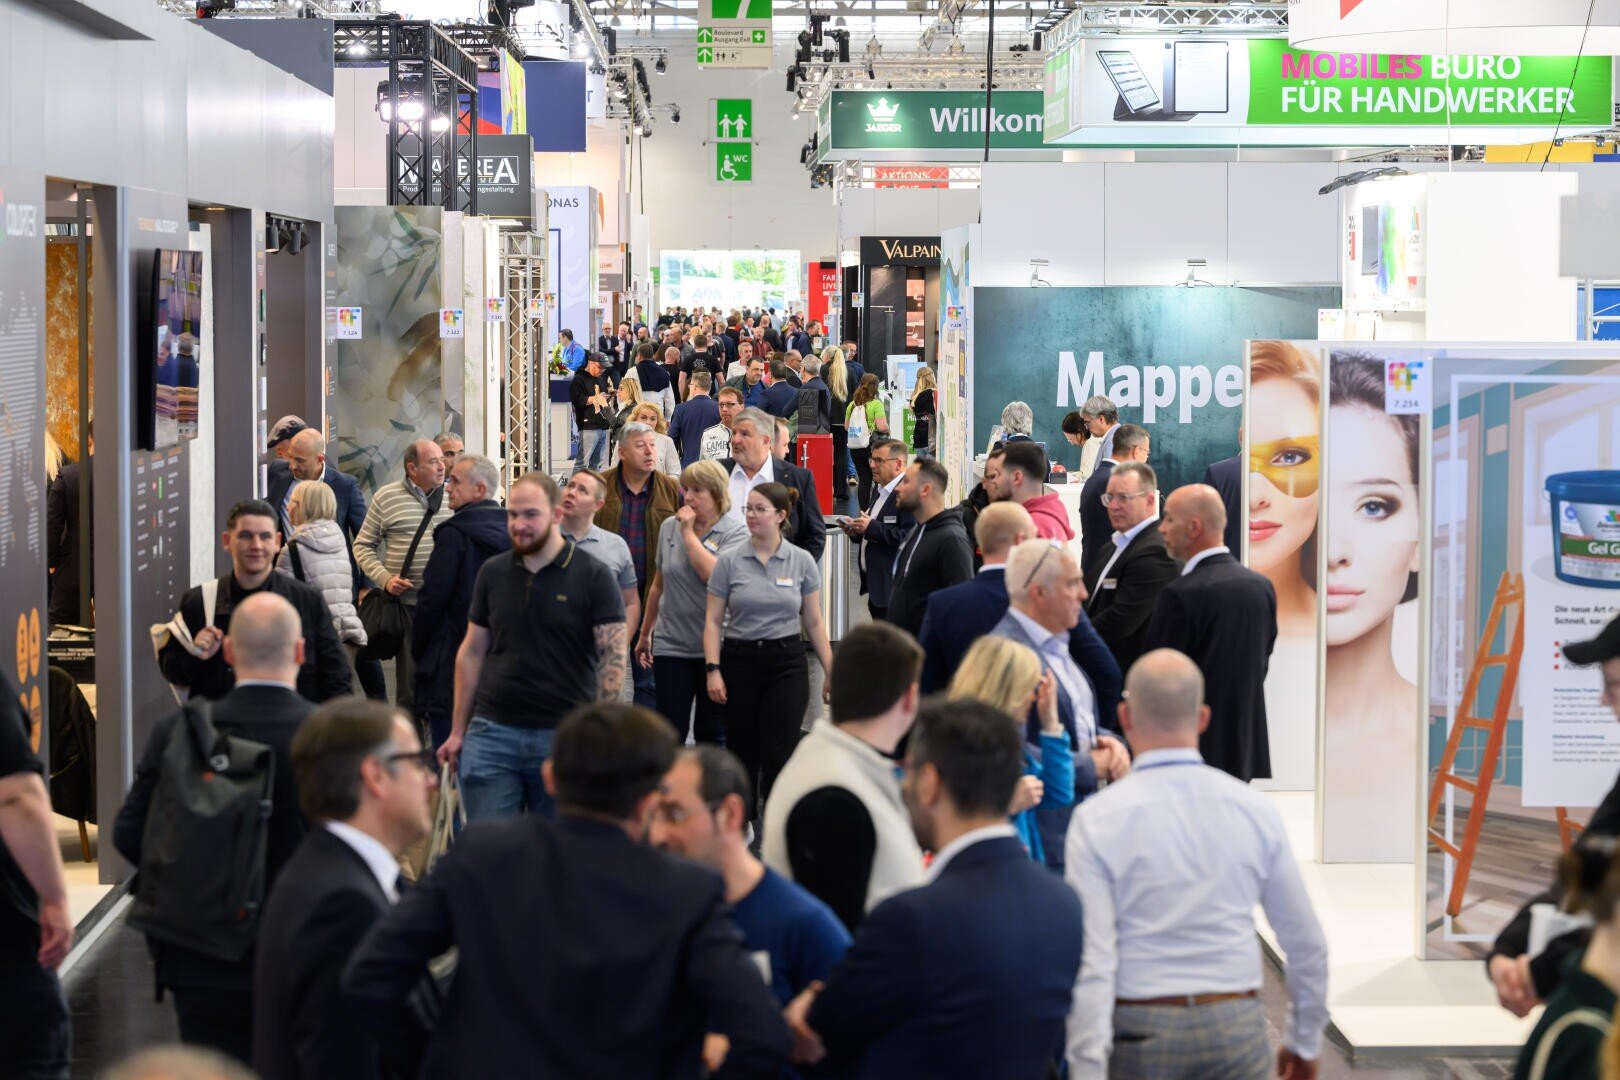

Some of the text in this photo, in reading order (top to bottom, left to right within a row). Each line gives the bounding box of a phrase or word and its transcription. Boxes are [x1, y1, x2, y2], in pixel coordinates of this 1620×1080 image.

[1281, 54, 1422, 79] MOBILES
[1281, 80, 1577, 113] FÜR HANDWERKER
[865, 123, 902, 133] JAEGER
[733, 154, 748, 163] WC
[1588, 542, 1608, 554] Gel
